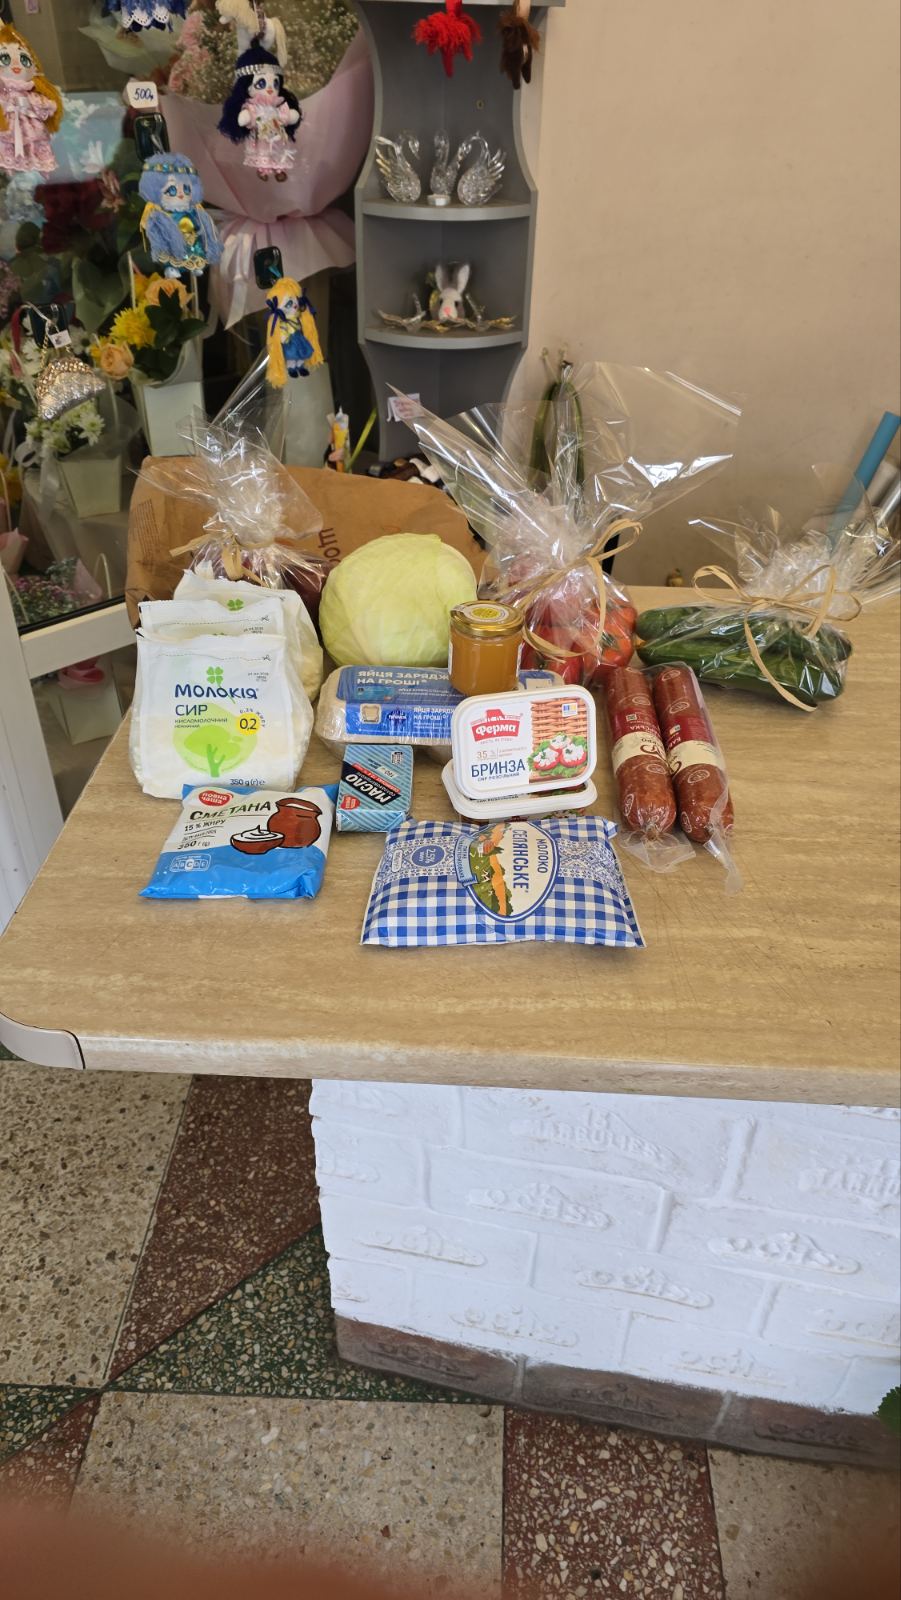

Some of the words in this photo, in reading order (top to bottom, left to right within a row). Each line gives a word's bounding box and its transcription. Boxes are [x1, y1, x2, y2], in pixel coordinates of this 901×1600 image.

[358, 670, 392, 678] ЯЙЦЯ
[176, 704, 208, 716] СИР
[476, 724, 516, 736] Ферма
[477, 750, 487, 760] 35
[471, 758, 526, 778] БРИНЗА
[346, 774, 392, 804] МАСЛО
[512, 829, 529, 889] СЕЛЯНСЬКЕ
[536, 838, 548, 874] МОЛОКО
